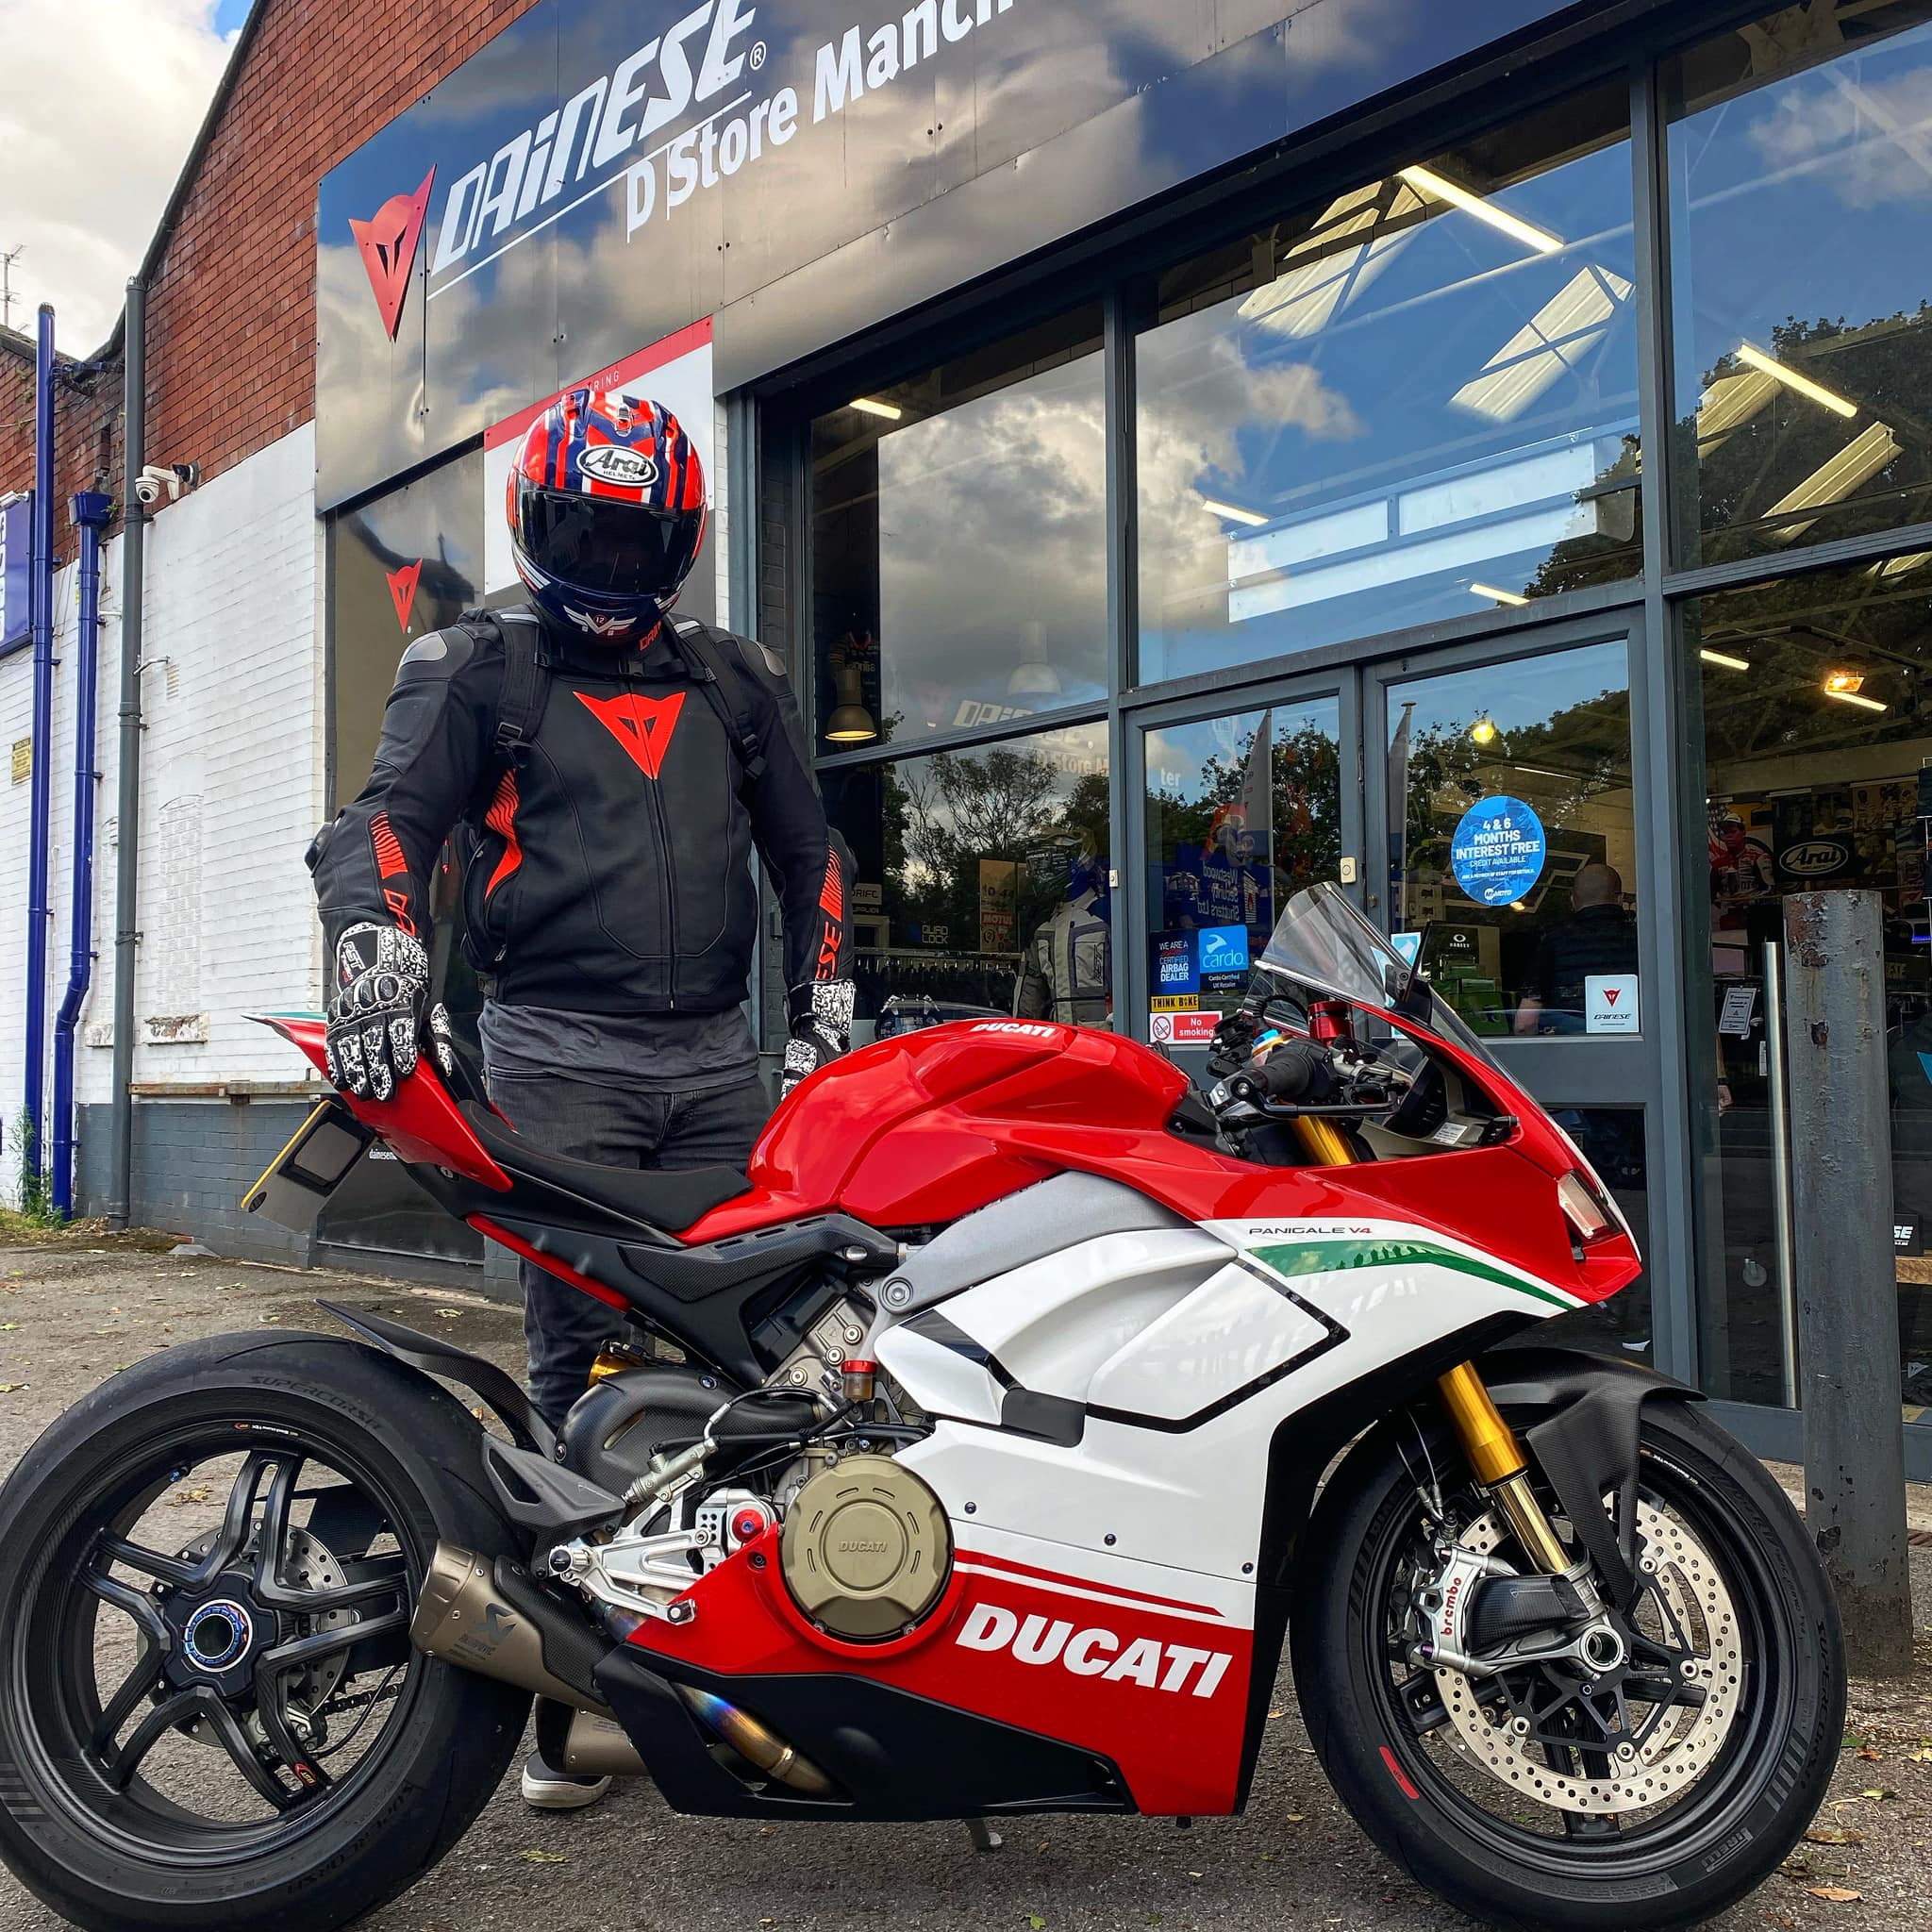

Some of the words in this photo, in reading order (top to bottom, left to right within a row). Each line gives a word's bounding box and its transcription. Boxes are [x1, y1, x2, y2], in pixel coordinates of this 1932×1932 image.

[668, 87, 798, 211] Store
[585, 450, 649, 476] Arai
[1483, 820, 1491, 830] 4
[1492, 819, 1502, 830] &
[1504, 817, 1511, 828] 6
[1474, 830, 1521, 845] MONTHS
[1456, 843, 1510, 859] INTEREST
[1511, 841, 1541, 855] FREE
[1787, 847, 1838, 866] Arai
[1471, 858, 1491, 868] CREDIT
[1492, 856, 1526, 865] AVAILABLE
[342, 941, 366, 970] RST
[1159, 955, 1189, 965] CERTIFIED
[1203, 949, 1244, 968] cardo
[1160, 963, 1190, 973] AIRBAG
[1160, 973, 1190, 982] DEALER
[1153, 997, 1175, 1008] THINK
[1191, 1018, 1202, 1026] No
[970, 1023, 1056, 1038] DUCATI
[1179, 1026, 1214, 1038] smoking
[839, 1540, 888, 1553] DUCATI
[955, 1602, 1233, 1698] DUCATI
